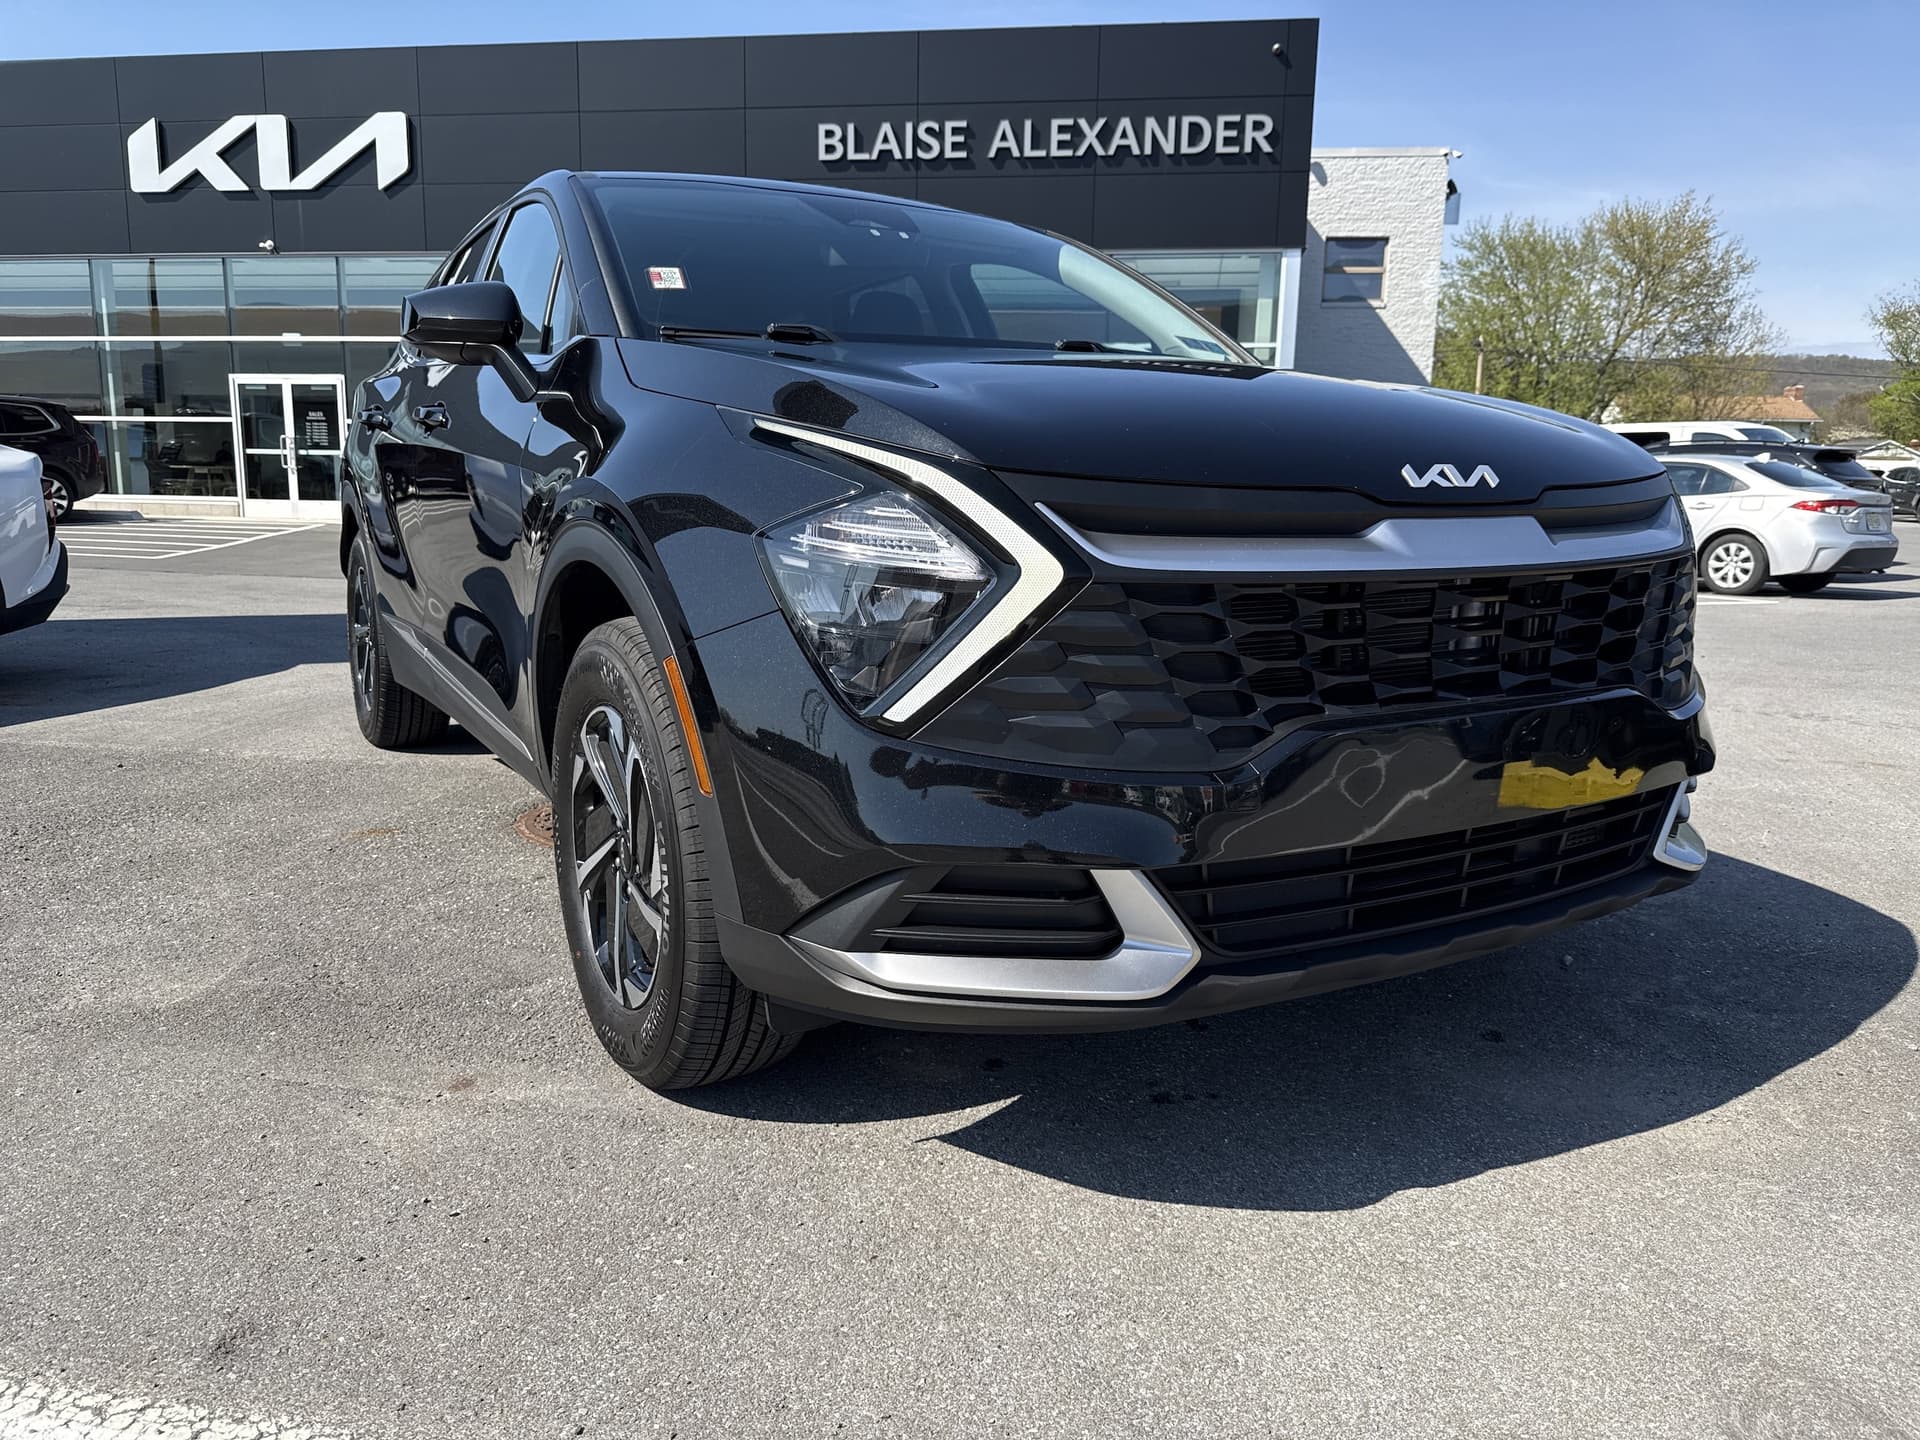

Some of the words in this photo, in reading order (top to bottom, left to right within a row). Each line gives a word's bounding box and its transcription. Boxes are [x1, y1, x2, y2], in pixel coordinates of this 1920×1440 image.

[127, 111, 410, 193] KIA
[817, 120, 968, 161] BLAISE
[987, 114, 1275, 159] ALEXANDER
[1401, 463, 1500, 488] KIA
[656, 821, 670, 956] KUMHO
